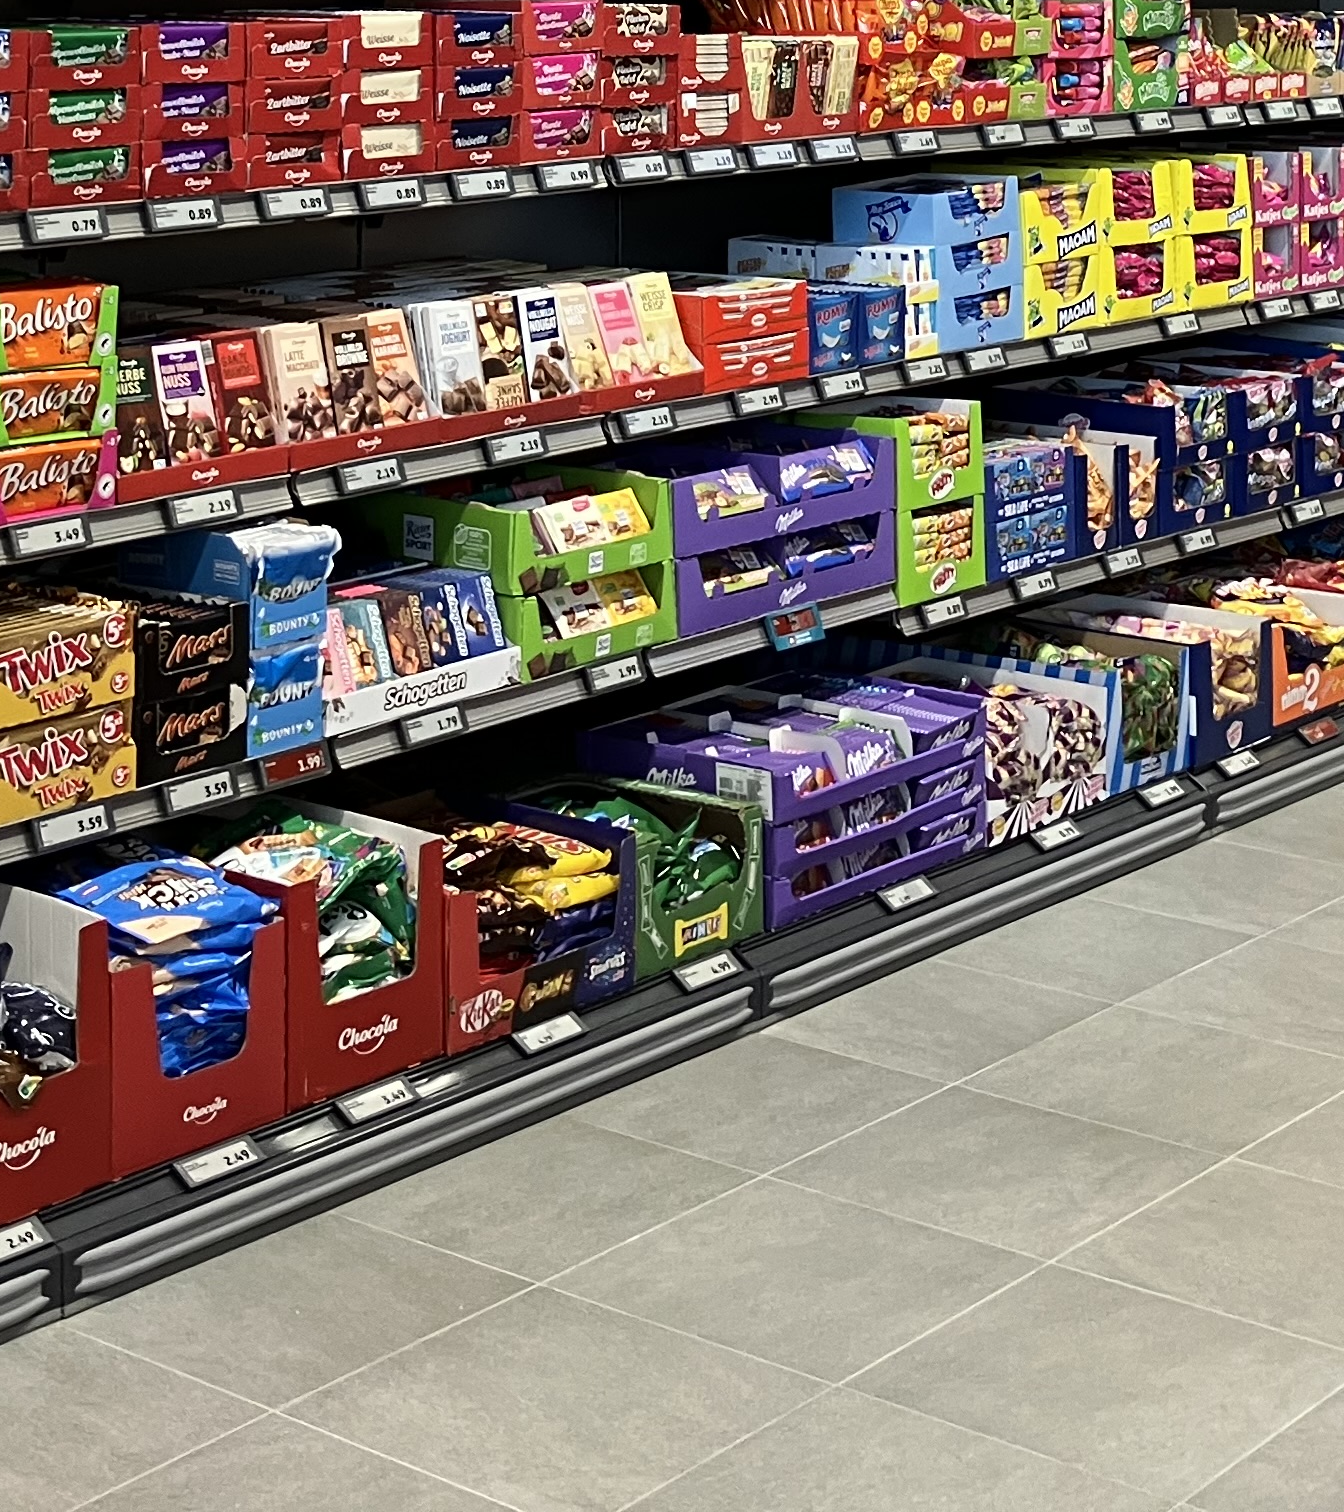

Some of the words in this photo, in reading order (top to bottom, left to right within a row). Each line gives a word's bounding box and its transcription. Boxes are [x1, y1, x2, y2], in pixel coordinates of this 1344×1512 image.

[72, 219, 96, 232] 0.79
[1059, 221, 1096, 257] MAOAM
[866, 295, 898, 318] ROMY
[209, 500, 231, 513] 2.19
[55, 528, 79, 542] 3.49
[269, 614, 311, 635] BOUNTY
[166, 625, 231, 669] Mars
[384, 670, 466, 710] Schogetten
[298, 756, 321, 771] 1.99
